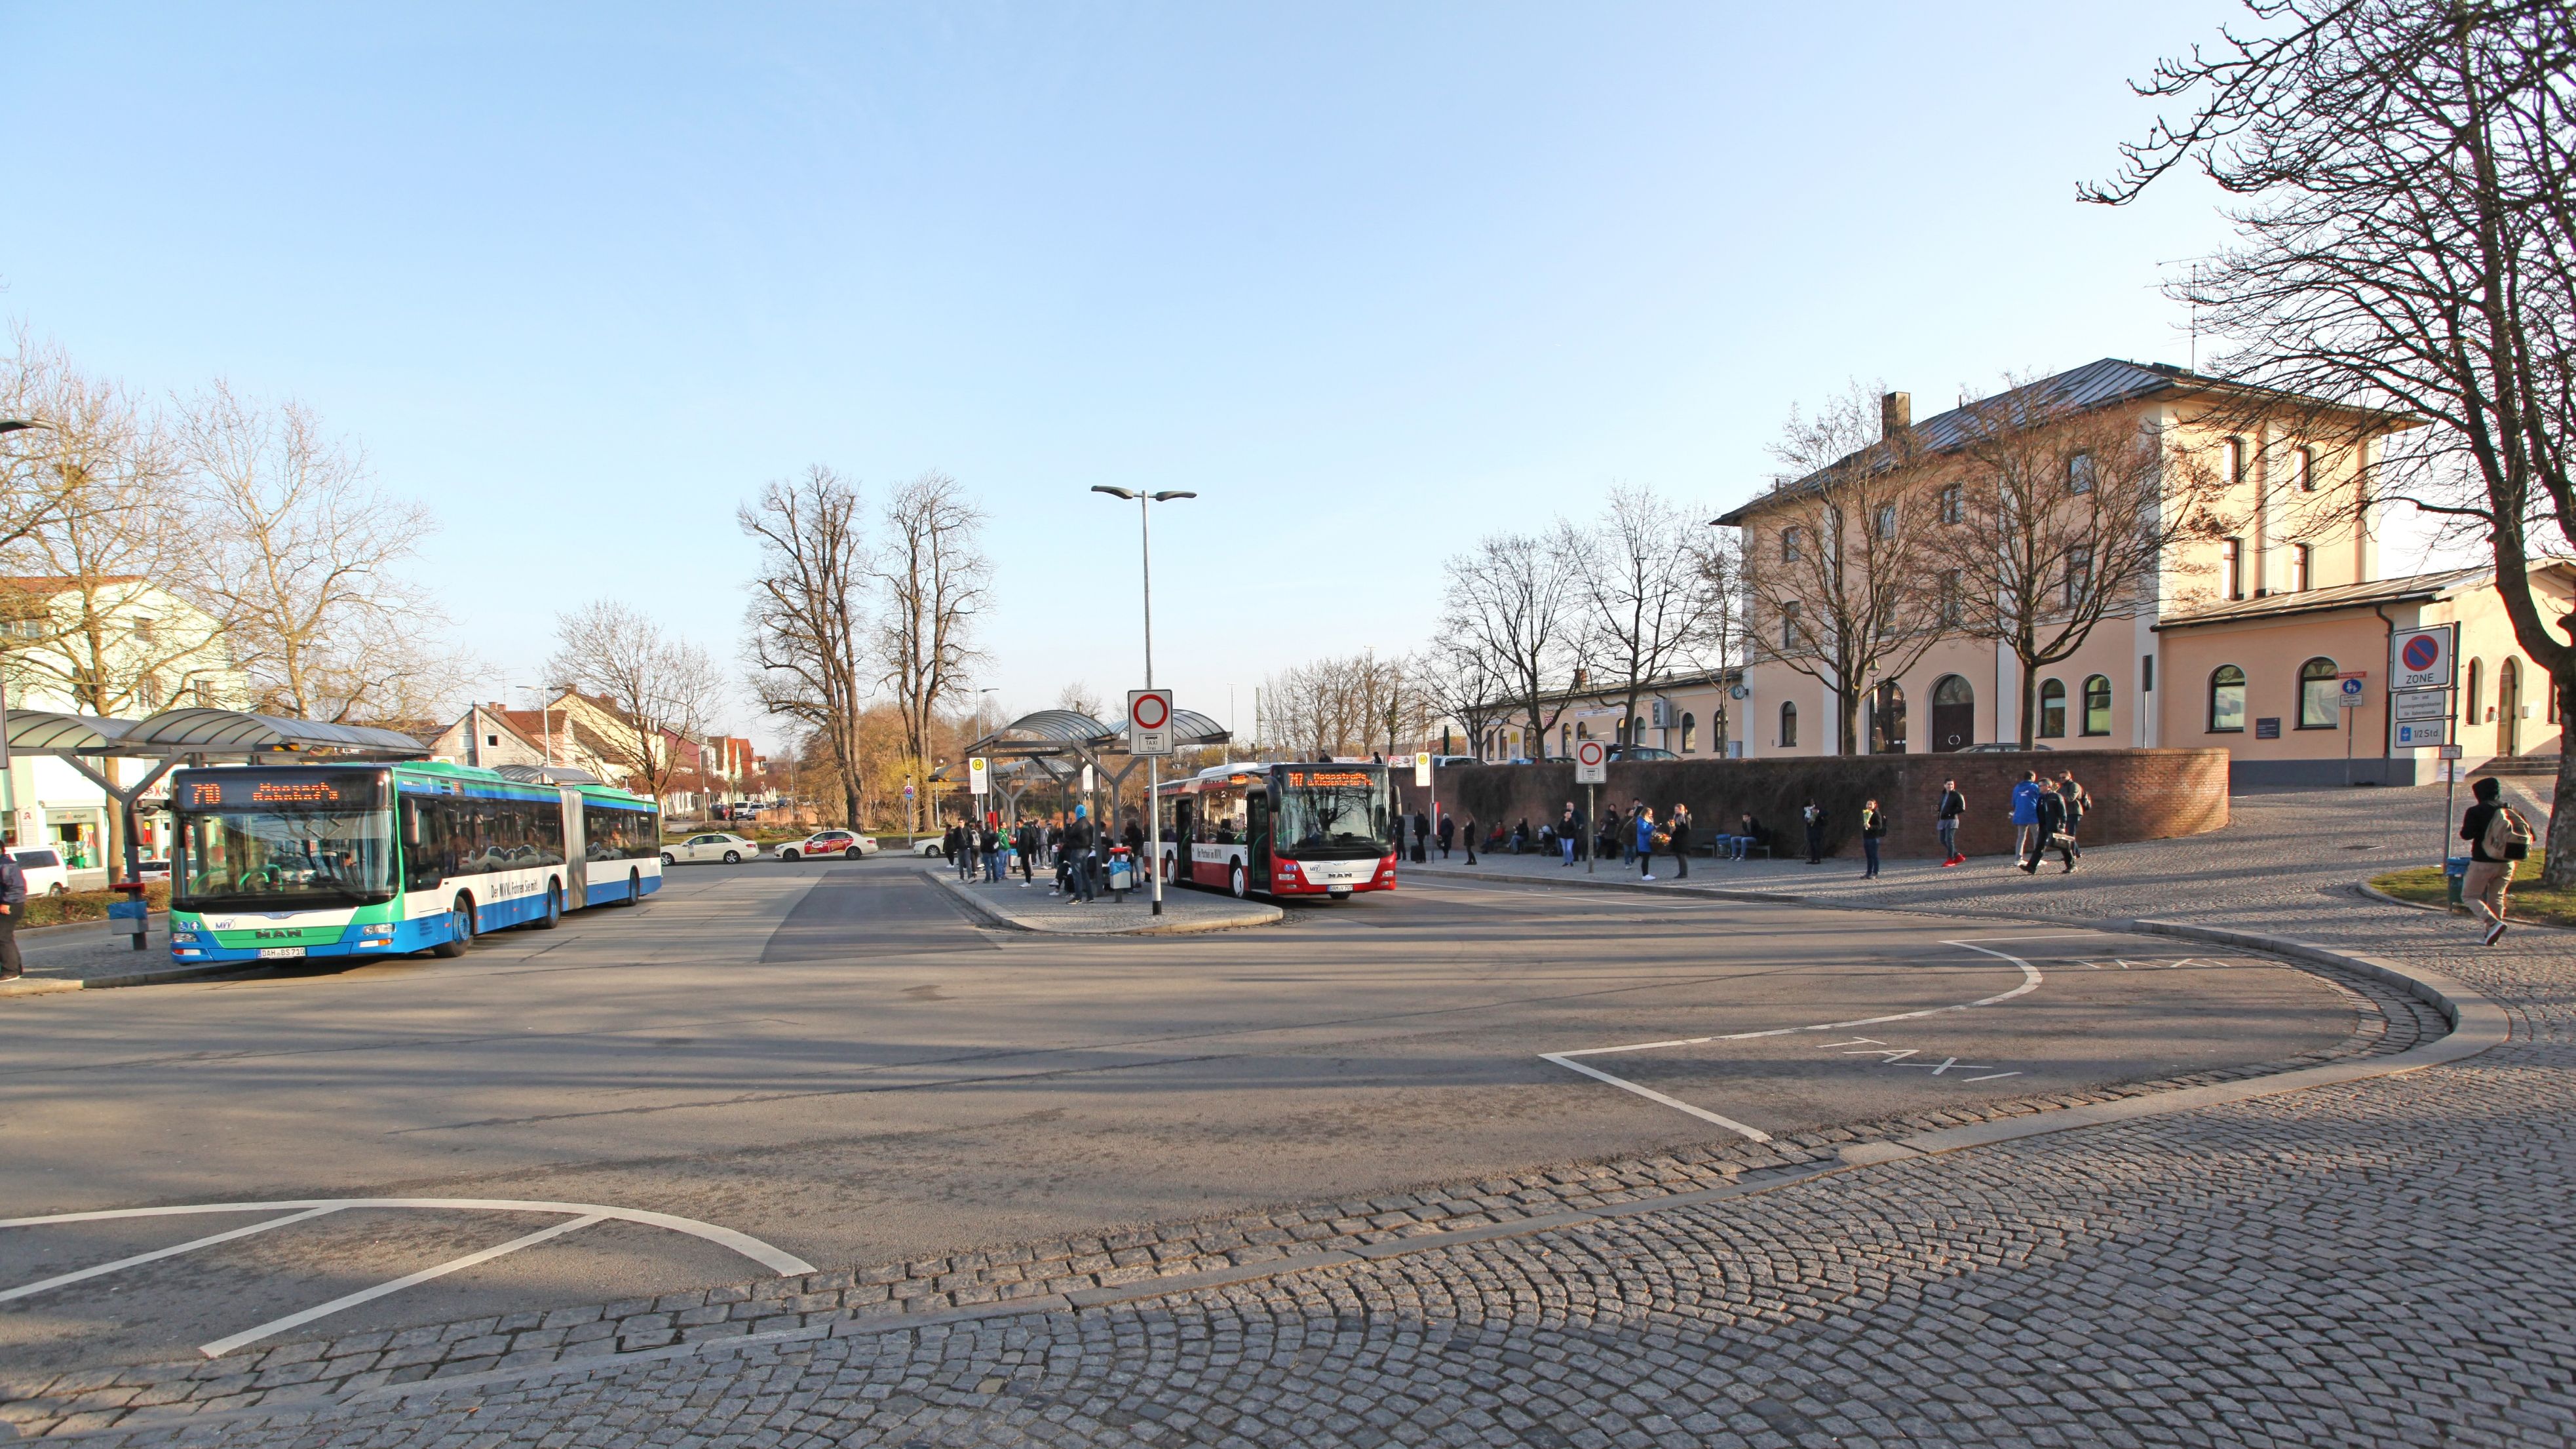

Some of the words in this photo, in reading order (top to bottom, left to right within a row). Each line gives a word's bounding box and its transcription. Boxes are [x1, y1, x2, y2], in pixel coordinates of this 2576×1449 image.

[2406, 673, 2434, 684] ZONE
[2413, 729, 2423, 738] 1/2
[2425, 729, 2440, 737] Std.
[511, 881, 524, 895] Fahren
[256, 929, 302, 938] MAN
[2065, 958, 2231, 969] TAXI
